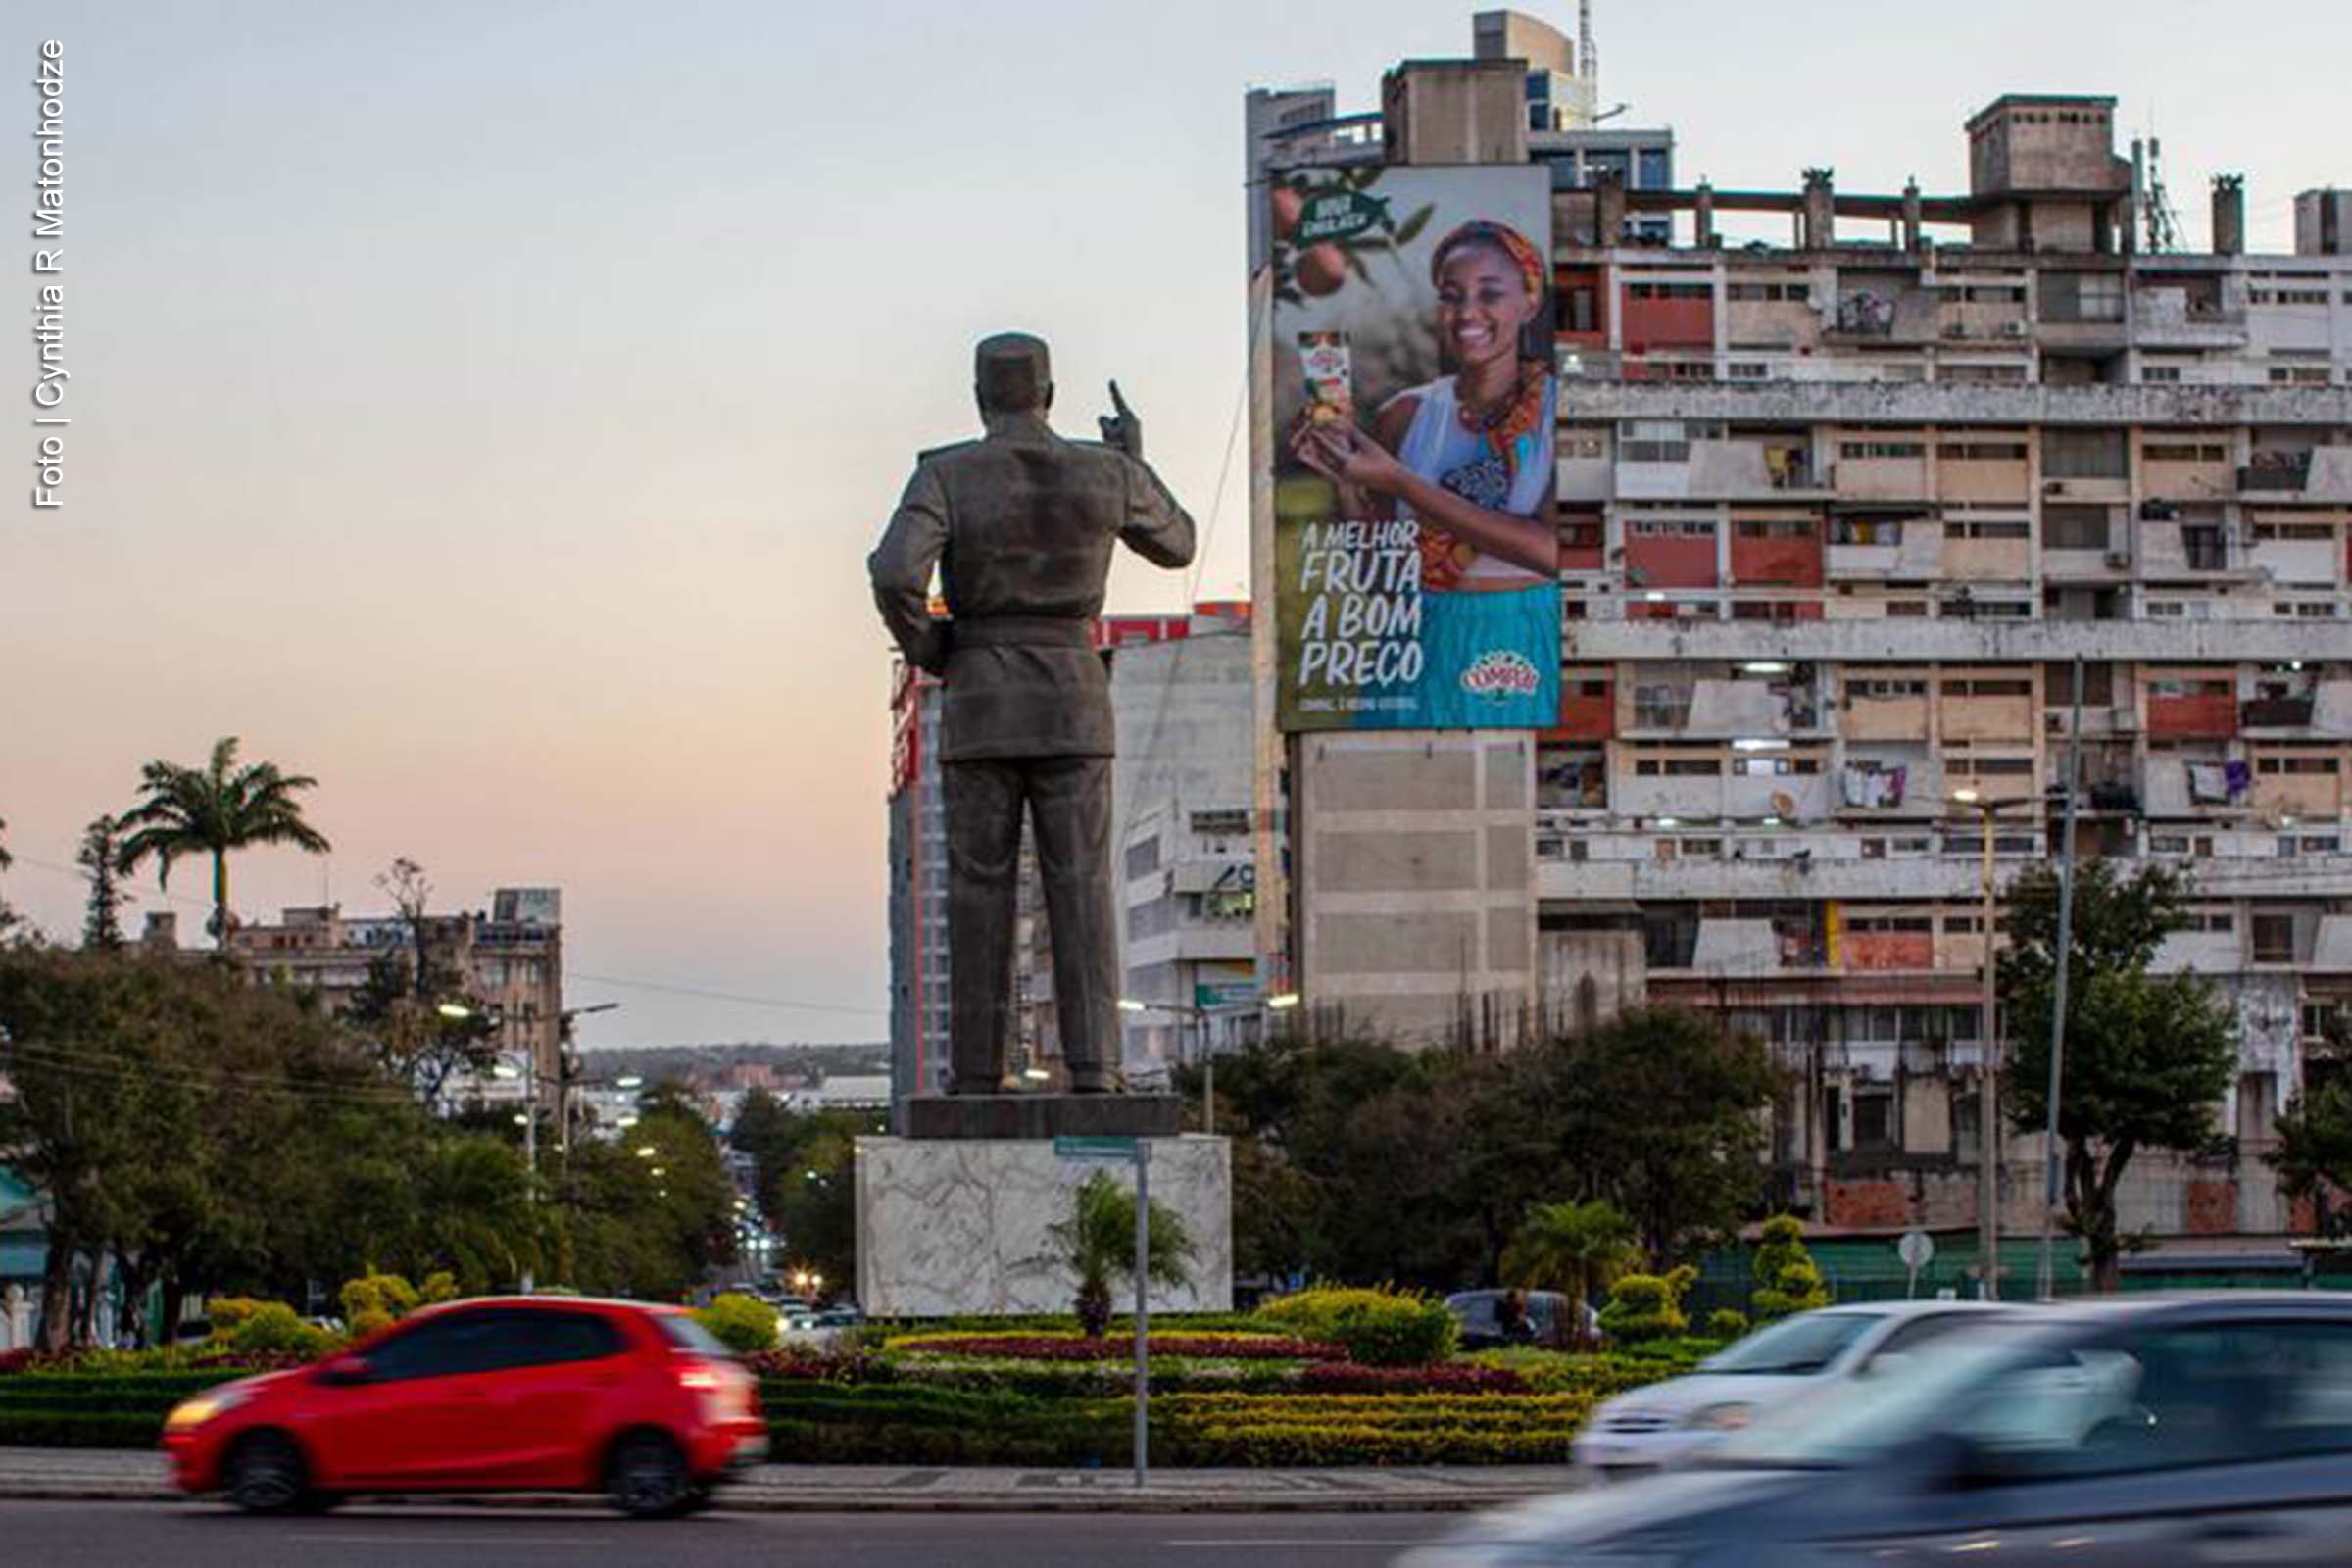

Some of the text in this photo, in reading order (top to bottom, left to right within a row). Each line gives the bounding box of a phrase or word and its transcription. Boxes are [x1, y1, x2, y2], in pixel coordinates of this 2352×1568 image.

[1301, 520, 1420, 550] A MELHOR
[1300, 549, 1422, 593] FRUTA
[1300, 593, 1422, 640] A BOM
[1298, 640, 1424, 688] PREÇO
